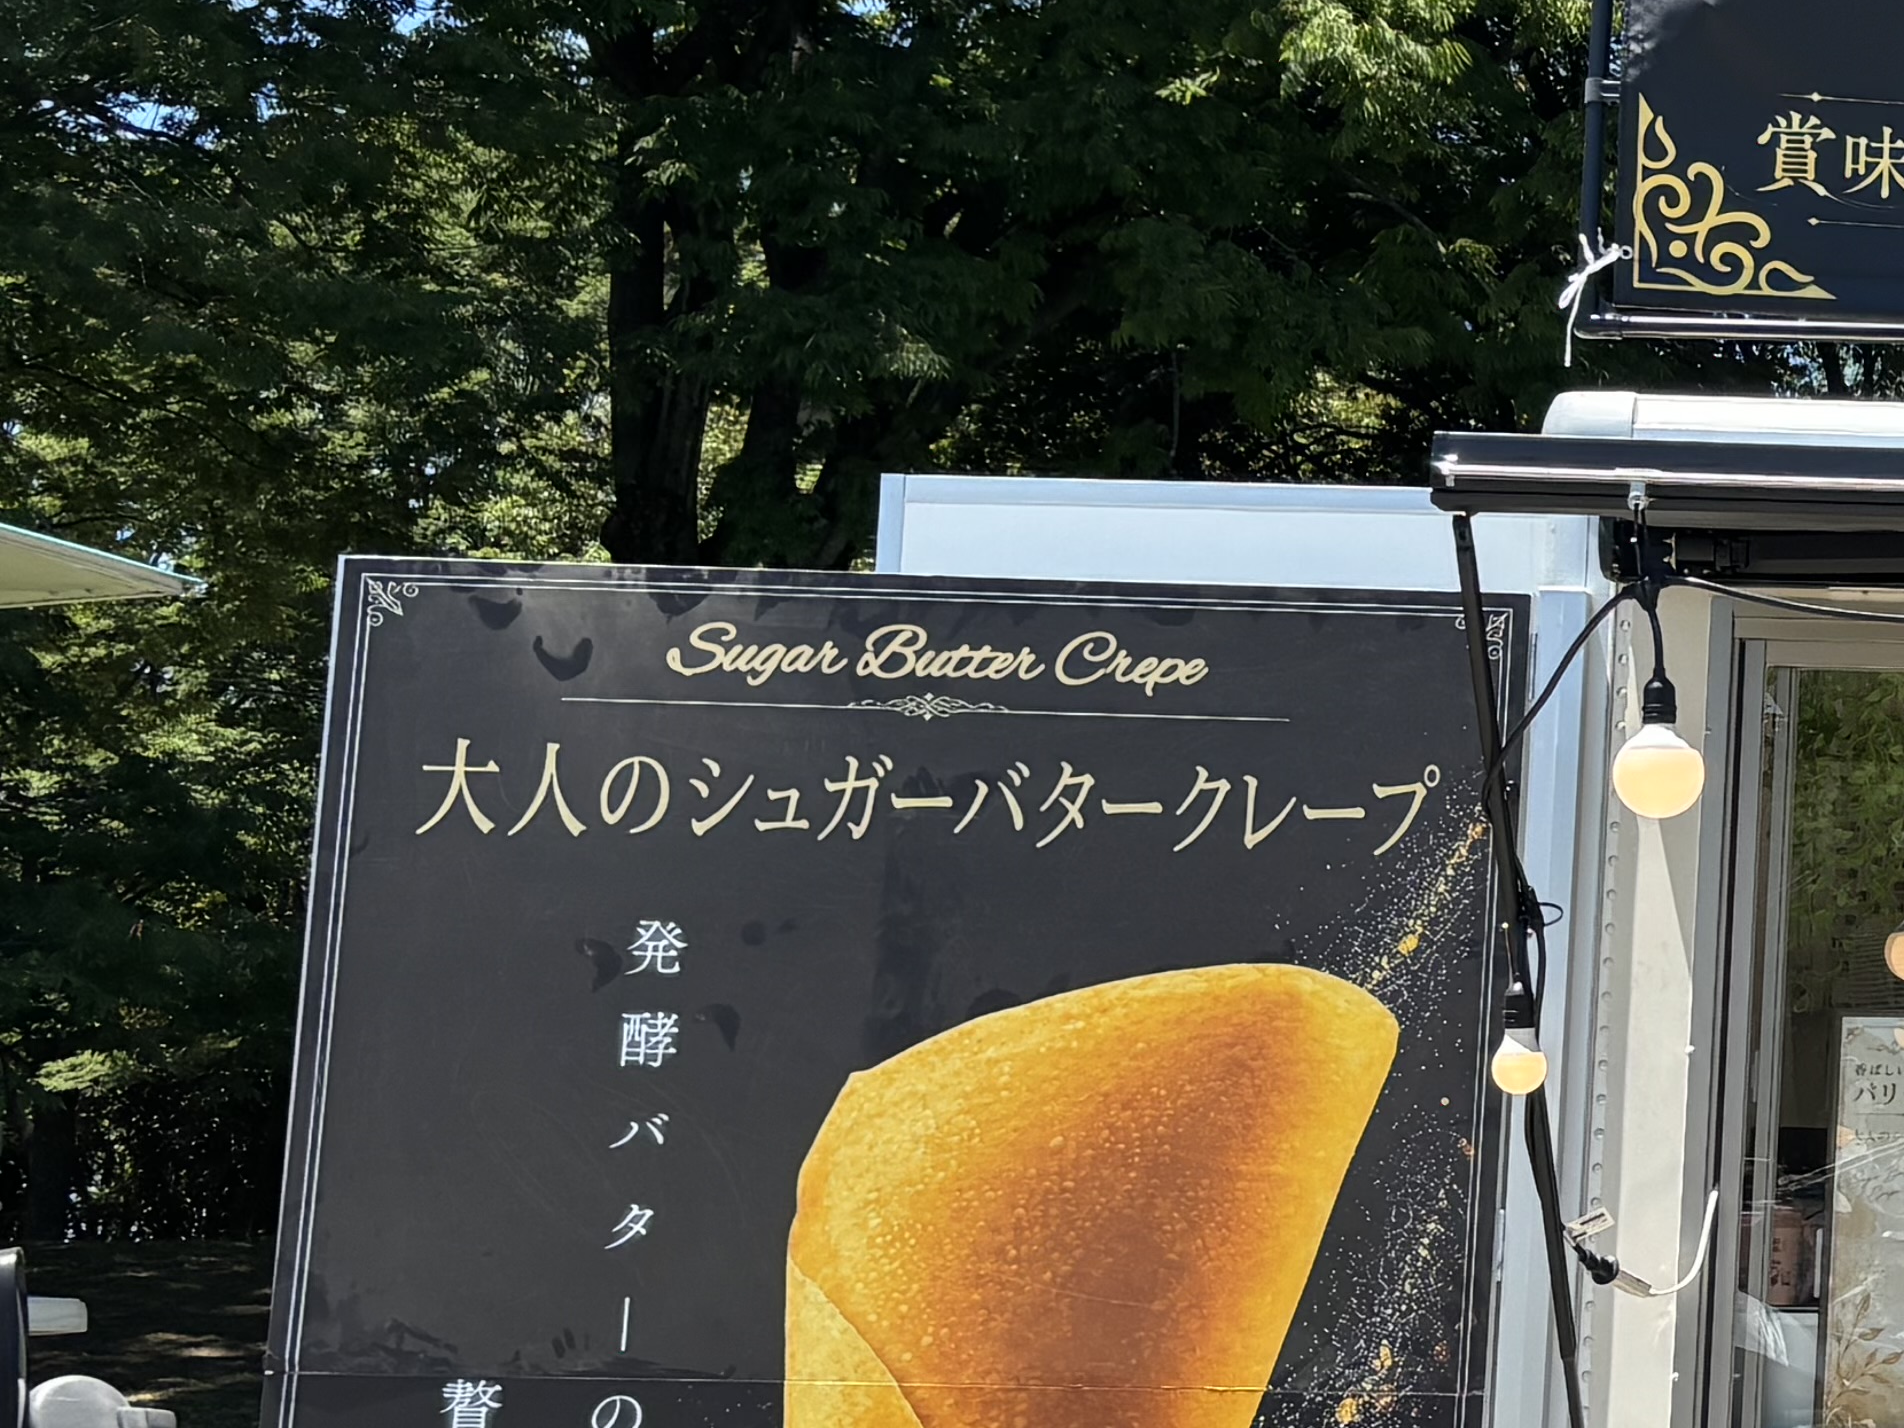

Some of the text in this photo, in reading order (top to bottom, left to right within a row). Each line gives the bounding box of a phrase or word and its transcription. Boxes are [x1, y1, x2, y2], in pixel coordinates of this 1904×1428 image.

[665, 621, 1211, 698] Sugar Butter Crepe
[414, 735, 1442, 859] 大人のシュガーバタークレープ
